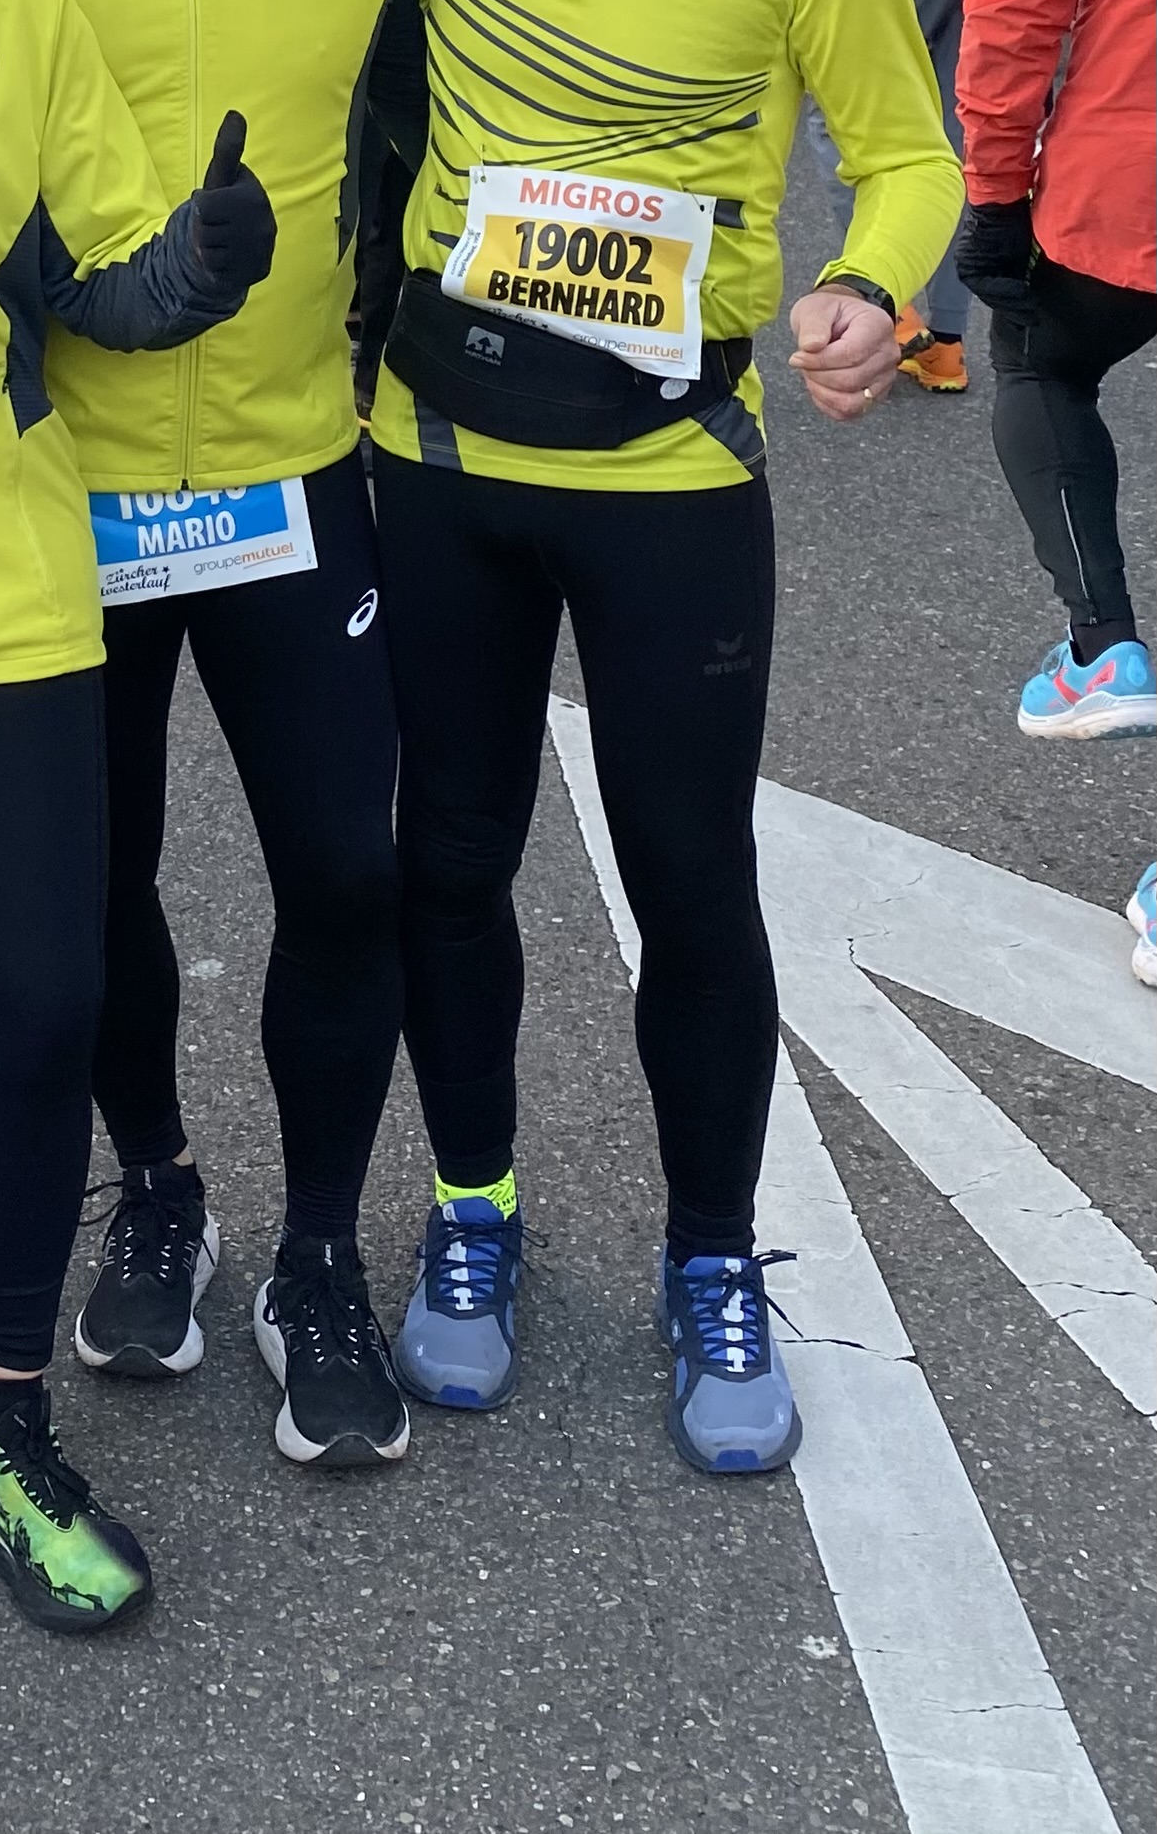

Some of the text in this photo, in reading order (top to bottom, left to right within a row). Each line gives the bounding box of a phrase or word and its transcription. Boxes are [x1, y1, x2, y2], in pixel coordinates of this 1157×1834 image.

[519, 177, 664, 222] MIGROS
[515, 221, 654, 285] 19002
[487, 269, 665, 327] BERNHARD
[137, 510, 236, 557] MARIO
[106, 564, 158, 586] Zürcher
[194, 542, 294, 578] groupemutuel
[100, 572, 172, 597] lvesterlauf
